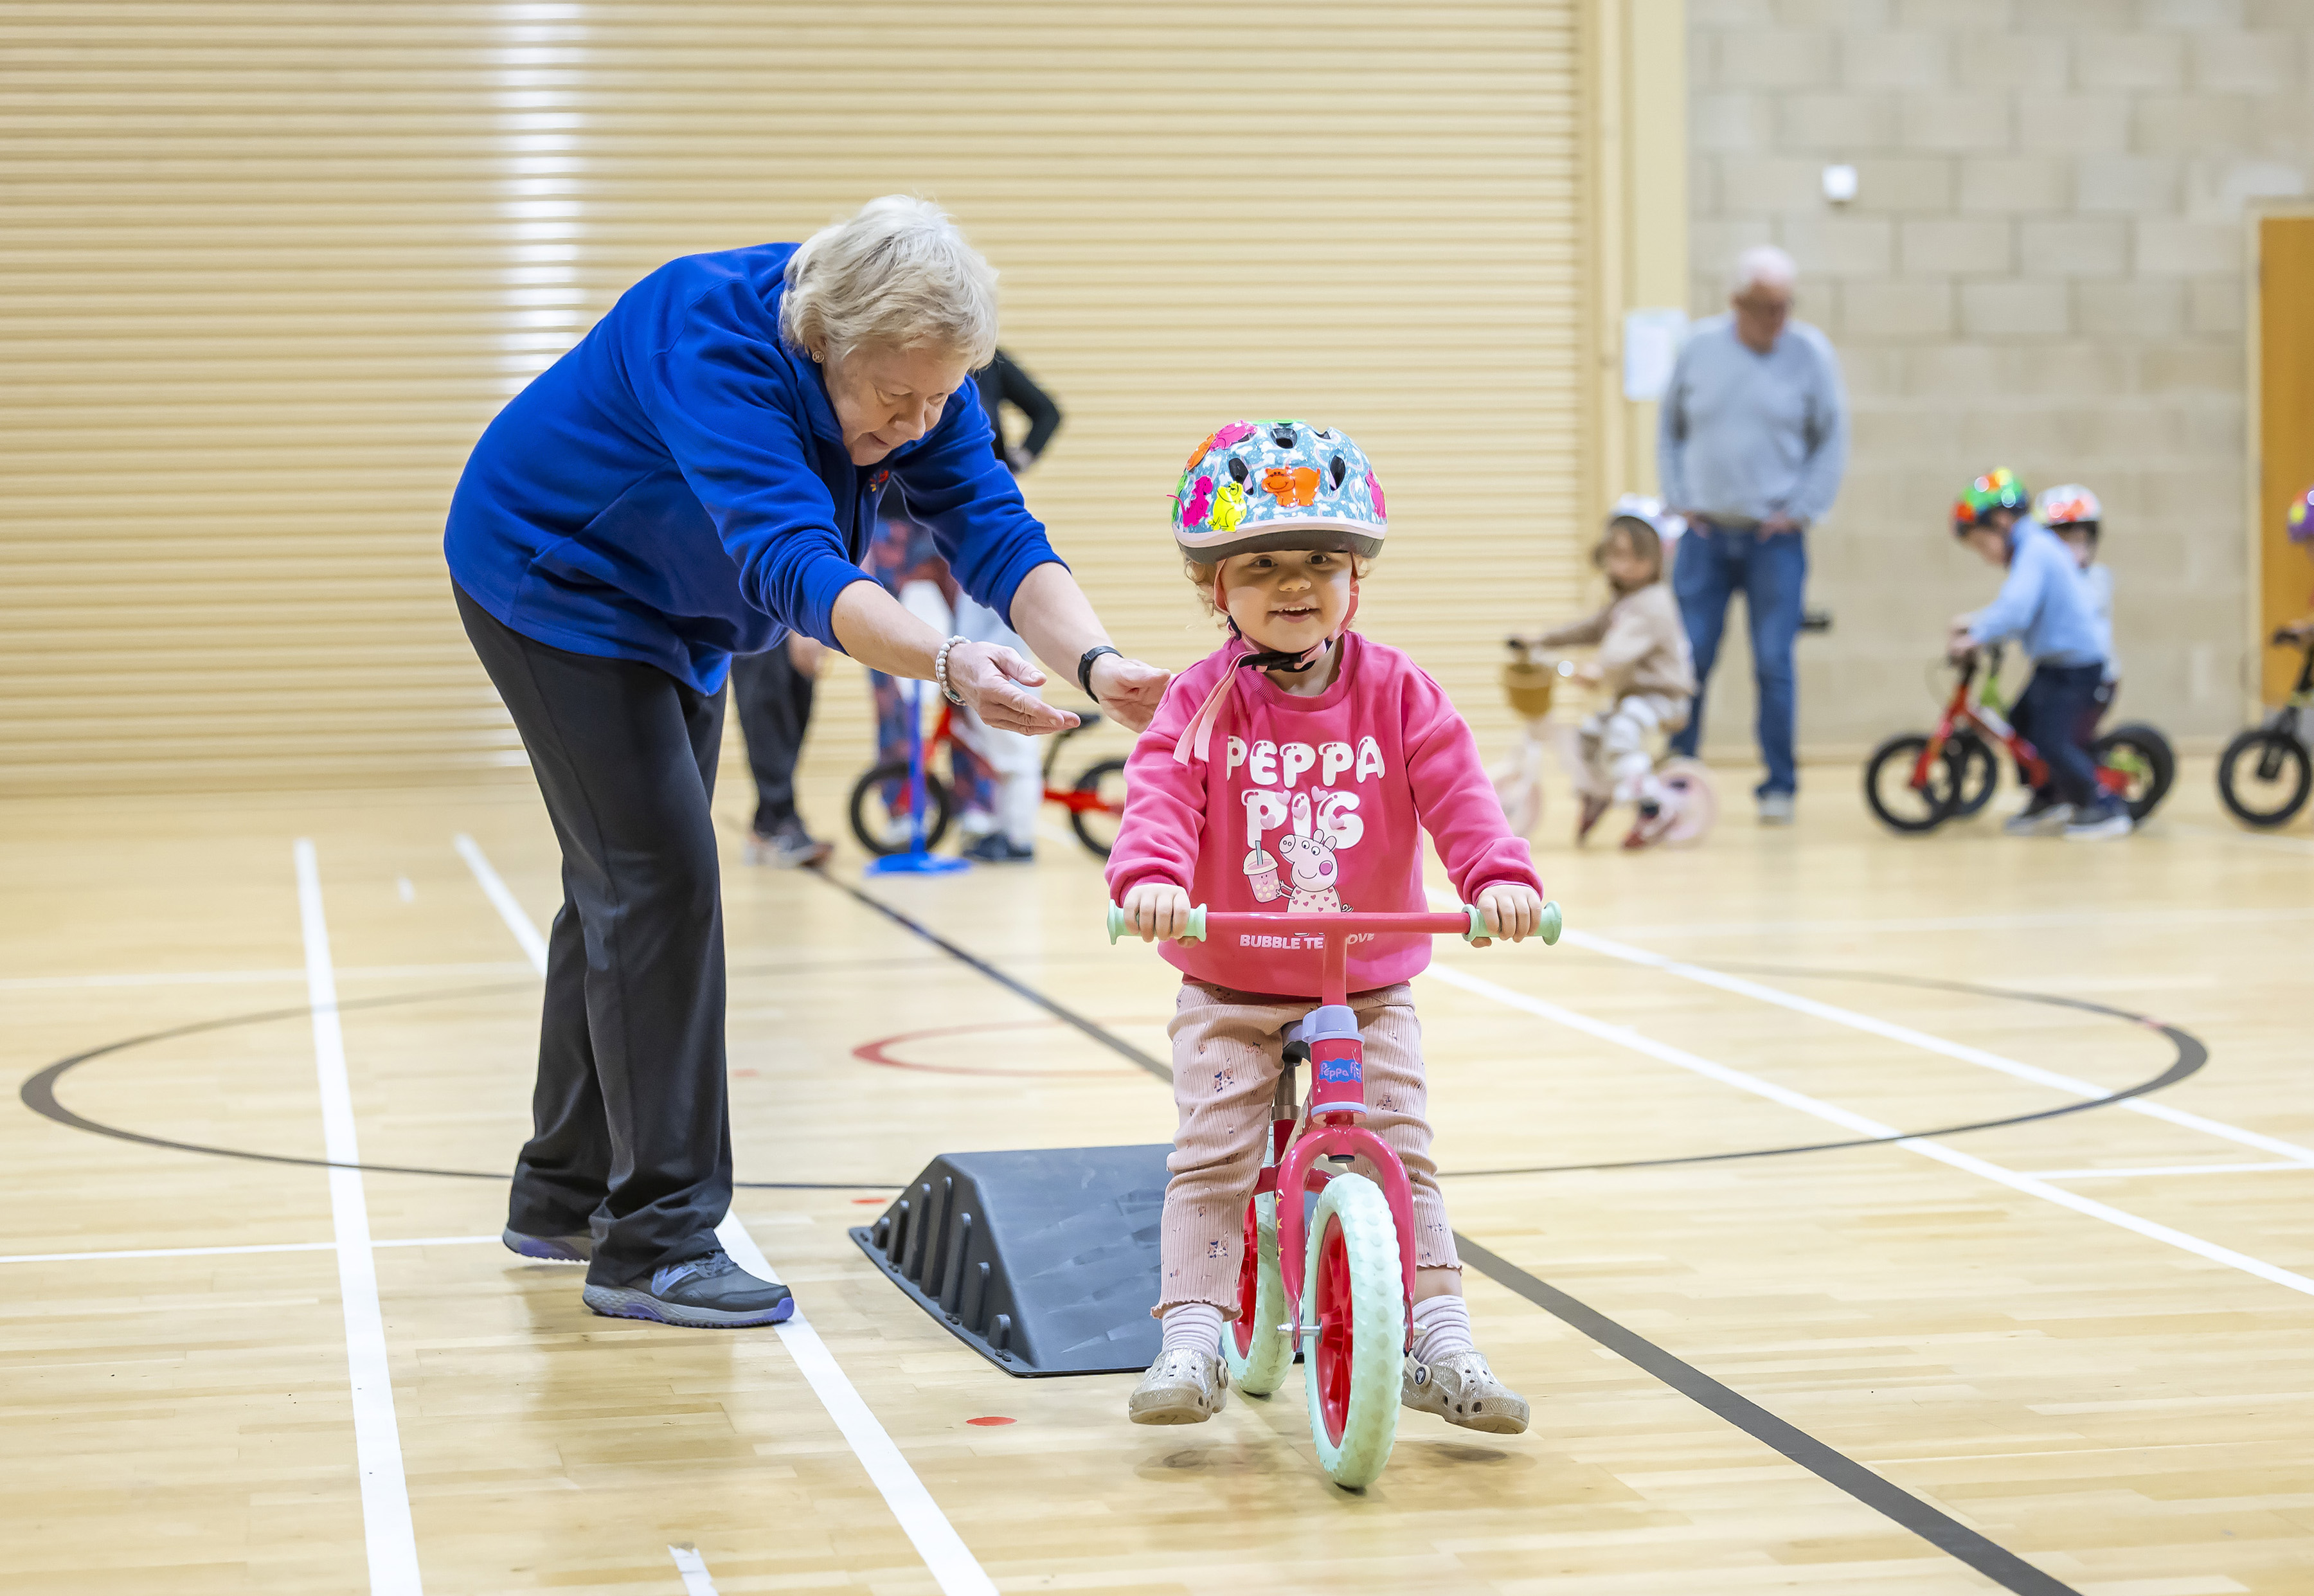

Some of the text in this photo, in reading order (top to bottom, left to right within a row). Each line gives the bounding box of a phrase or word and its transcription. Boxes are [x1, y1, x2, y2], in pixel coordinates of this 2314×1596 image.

[1227, 735, 1385, 789] PEPPA
[1241, 789, 1364, 850] PIG
[1239, 932, 1375, 950] BUBBLE TE OVE
[1321, 1062, 1349, 1080] Peppa
